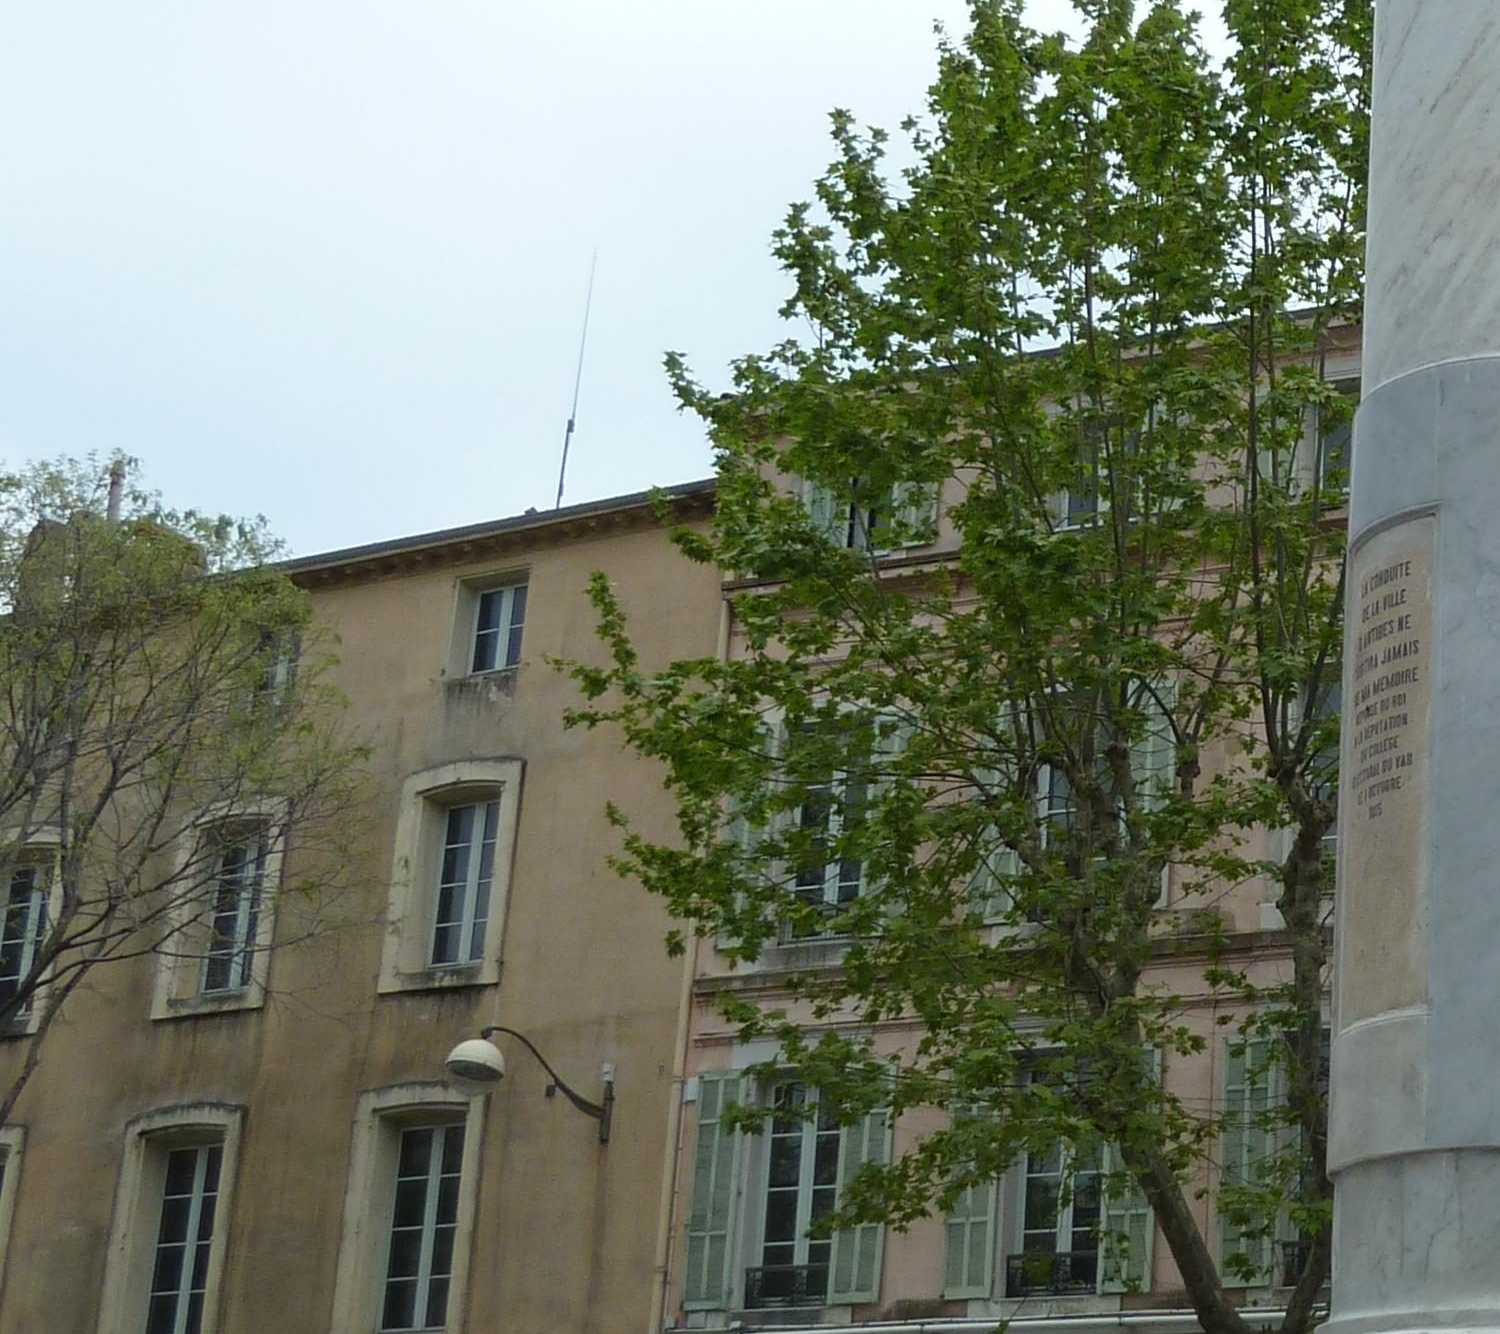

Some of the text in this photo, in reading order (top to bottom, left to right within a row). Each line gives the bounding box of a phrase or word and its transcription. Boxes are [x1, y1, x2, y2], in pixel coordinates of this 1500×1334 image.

[1383, 588, 1407, 611] VILLE
[1397, 613, 1412, 632] NE
[1381, 639, 1420, 665] JAMAIS
[1372, 666, 1419, 695] MEMOIRE
